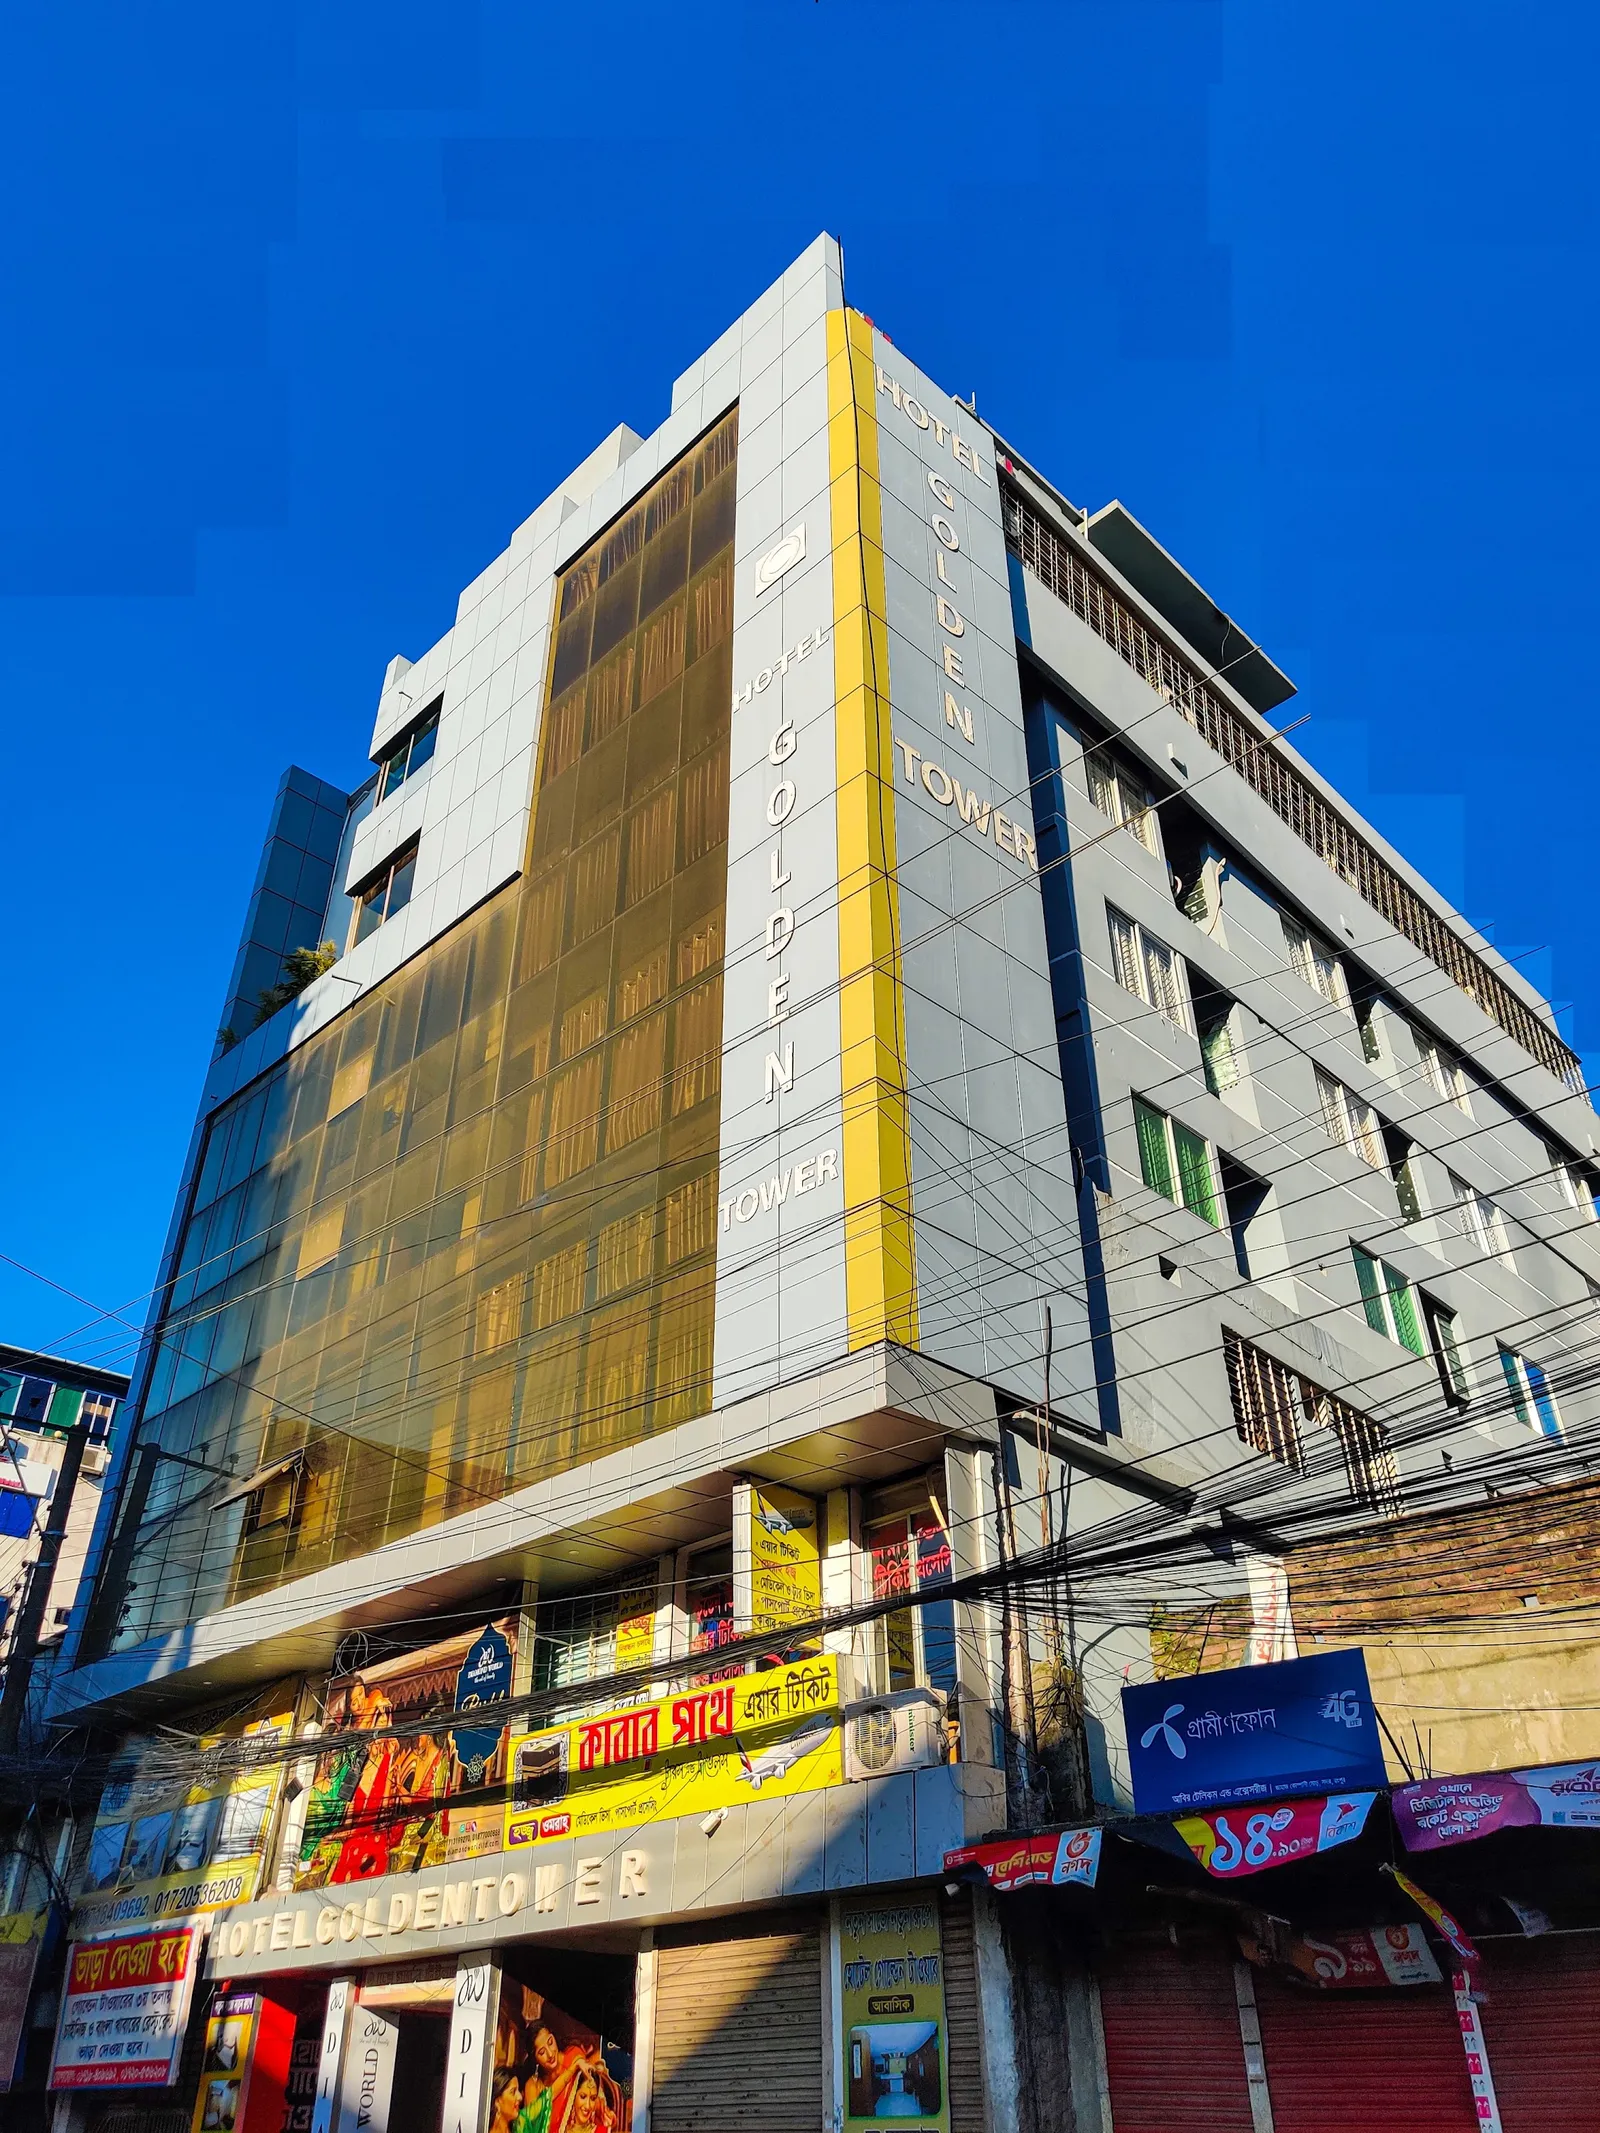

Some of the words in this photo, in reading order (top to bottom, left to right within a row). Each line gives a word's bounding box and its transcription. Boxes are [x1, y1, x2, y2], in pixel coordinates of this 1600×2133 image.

[875, 365, 991, 487] HOTEL
[927, 471, 974, 745] GOLDEN
[732, 626, 830, 713] HOTEL
[895, 737, 1039, 871] TOWER
[765, 718, 797, 1103] GOLDEN
[718, 1148, 839, 1232] TOWER
[578, 1705, 660, 1773] কাবার
[672, 1686, 737, 1748] পথে
[743, 1688, 780, 1721] এয়ার
[784, 1665, 833, 1714] টিকিট
[1187, 1707, 1277, 1740] গ্রামীণফোন
[1321, 1690, 1360, 1723] 4G
[908, 1709, 916, 1753] minister
[1409, 1794, 1456, 1814] ডিজিটাল
[1438, 1783, 1472, 1794] এখানে
[1415, 1809, 1448, 1829] রকেট
[1438, 1824, 1464, 1840] খোলা
[994, 1850, 1027, 1878] বেশি
[1061, 1858, 1093, 1876] নগদ
[154, 1877, 243, 1914] 01720536208
[75, 1946, 110, 1991] ভাড়া
[109, 1938, 156, 1982] দেওয়া
[158, 1934, 192, 1977] হবে
[844, 1953, 873, 1995] হোটেল
[907, 1948, 940, 1986] টাওয়ার
[872, 1996, 912, 2013] আবাসিক
[357, 2048, 379, 2130] WORLD
